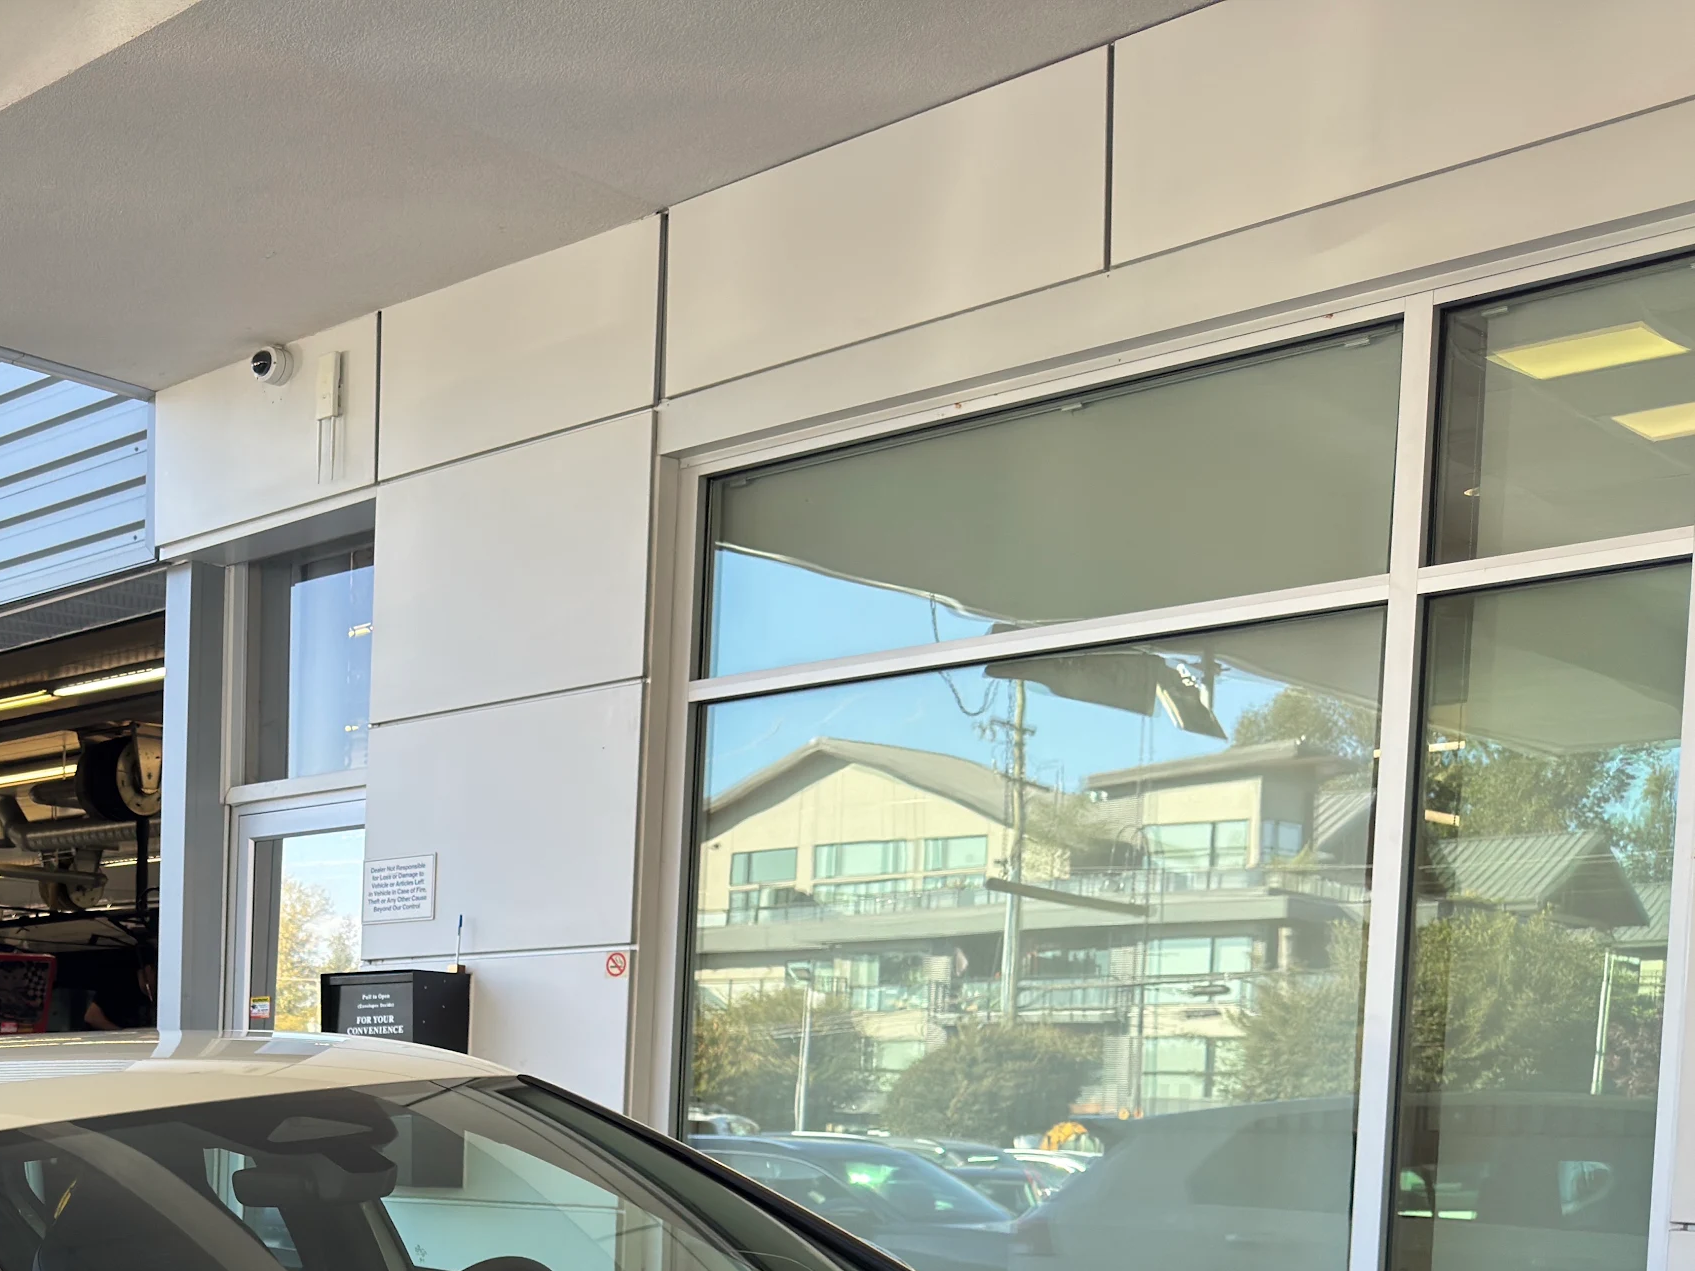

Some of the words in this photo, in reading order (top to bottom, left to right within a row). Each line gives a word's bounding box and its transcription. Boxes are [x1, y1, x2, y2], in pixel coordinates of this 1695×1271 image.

[396, 863, 426, 871] Responsible
[398, 871, 418, 879] Damage
[356, 1016, 372, 1024] FOR
[373, 1015, 394, 1024] YOUR
[347, 1025, 404, 1035] CONVENIENCE
